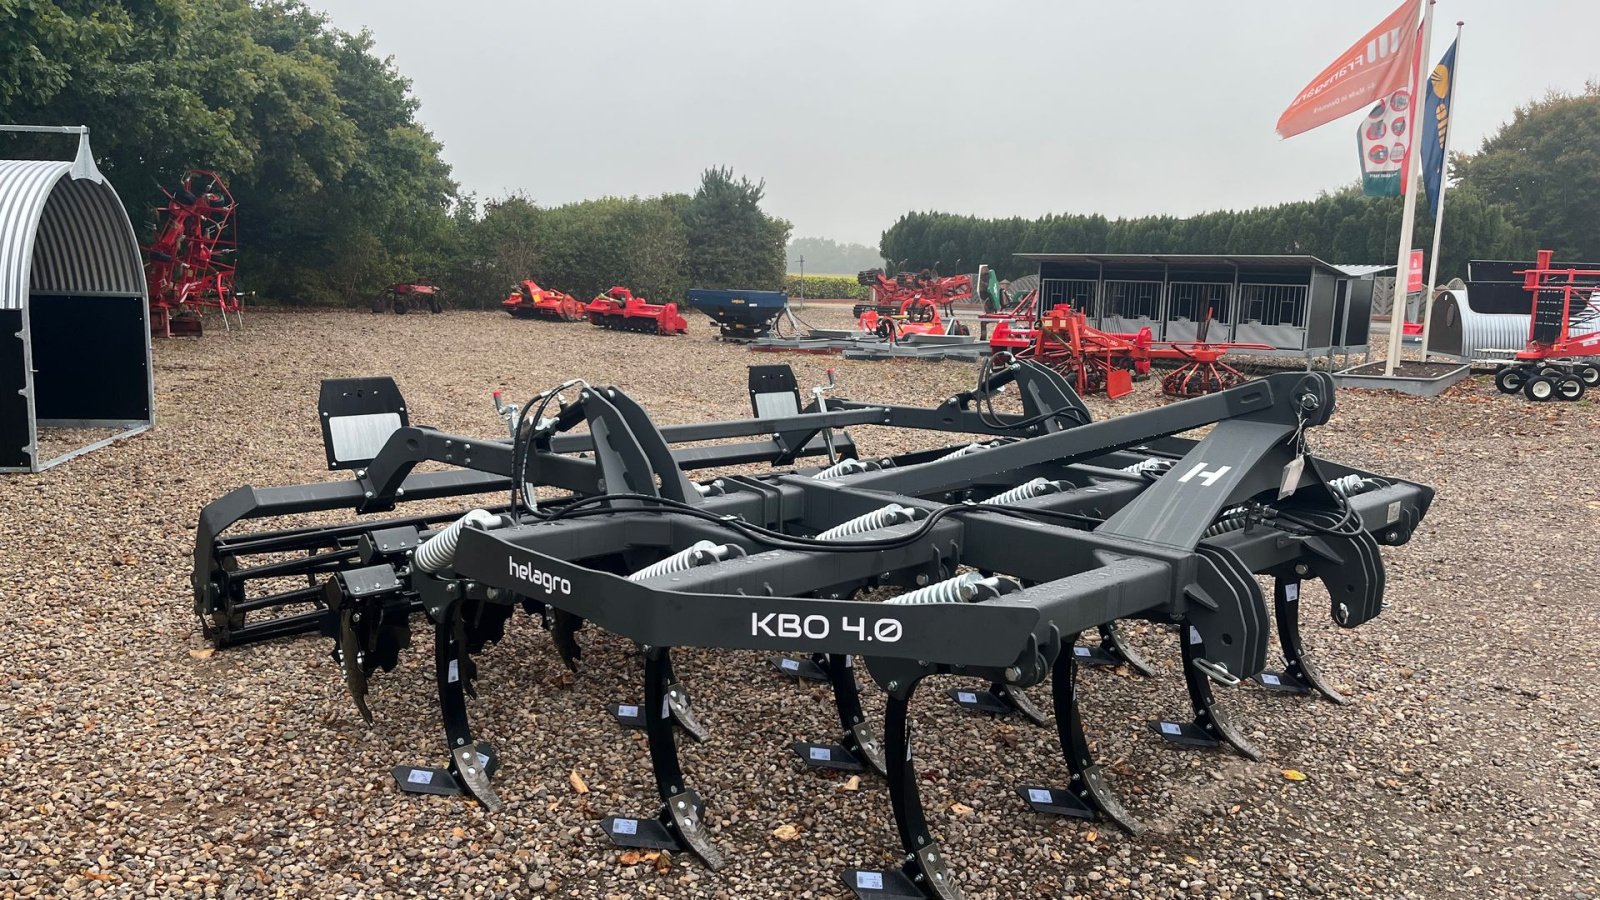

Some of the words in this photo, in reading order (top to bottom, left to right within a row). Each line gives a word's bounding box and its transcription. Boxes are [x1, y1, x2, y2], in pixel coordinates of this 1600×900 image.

[509, 555, 571, 595] helagro
[752, 612, 830, 639] KBO
[842, 616, 903, 642] 4.0
